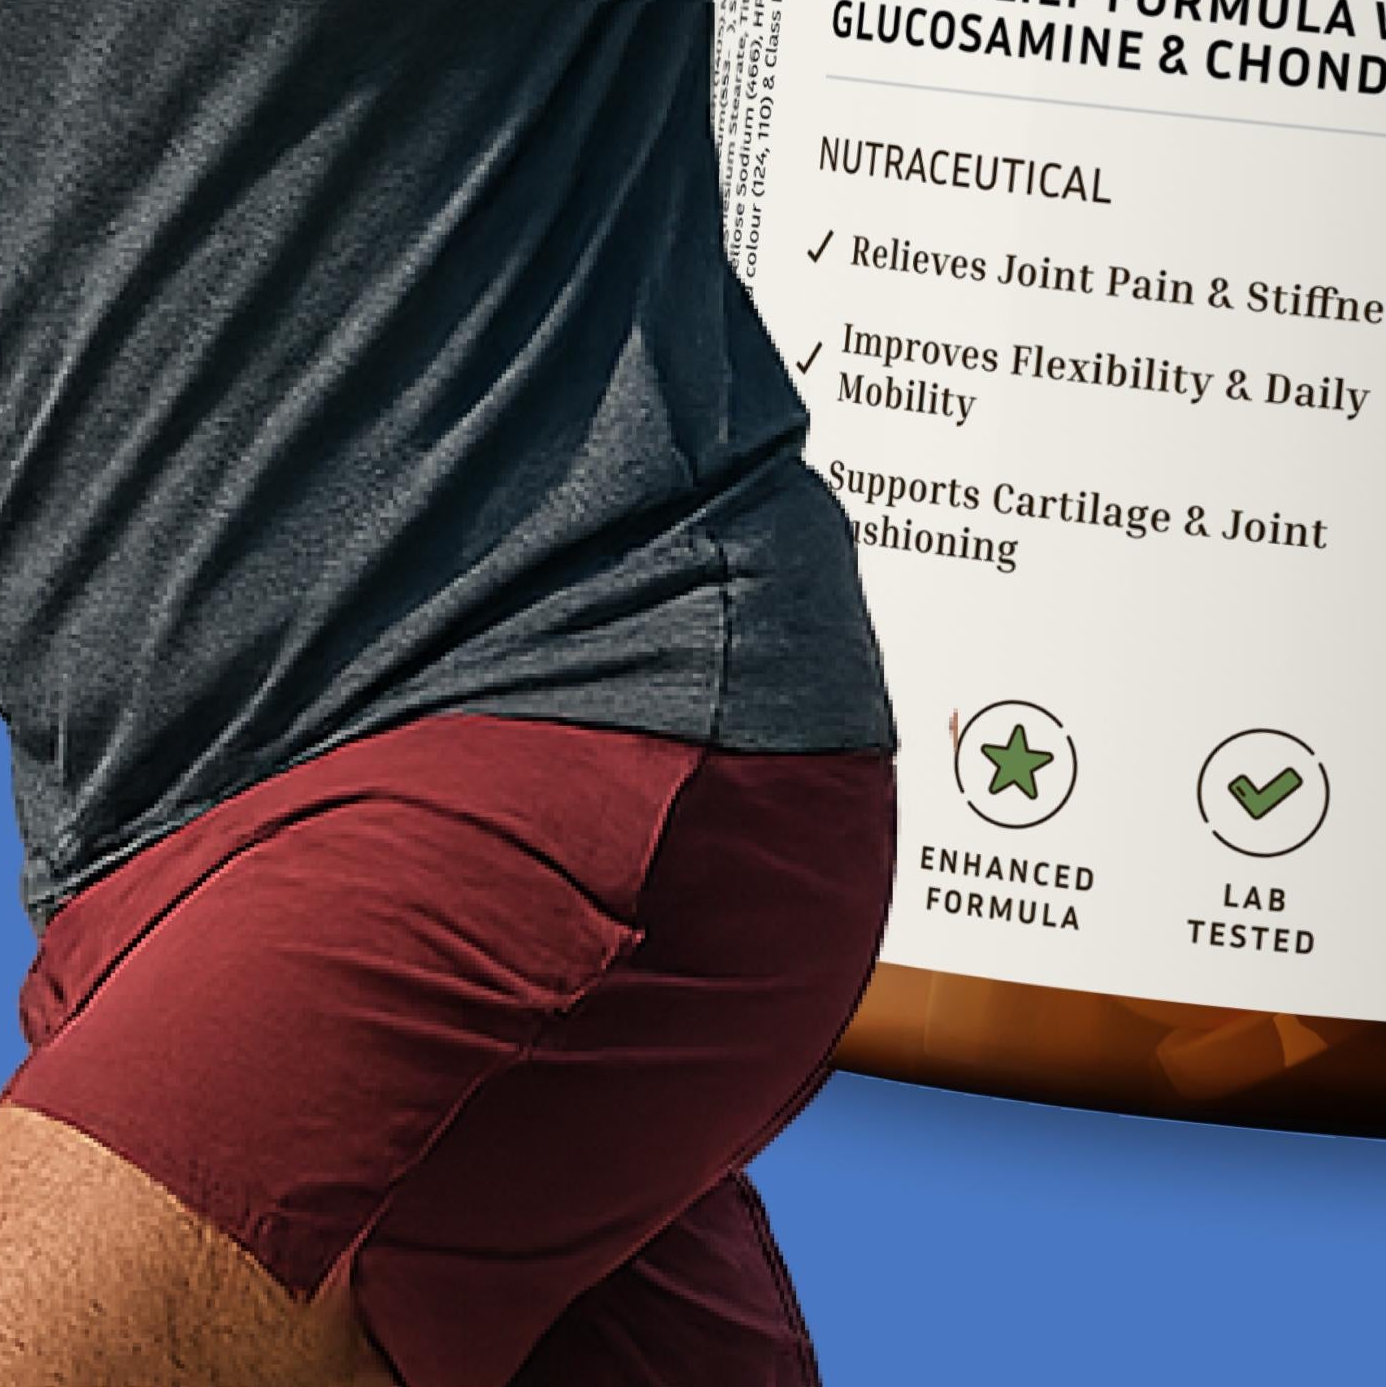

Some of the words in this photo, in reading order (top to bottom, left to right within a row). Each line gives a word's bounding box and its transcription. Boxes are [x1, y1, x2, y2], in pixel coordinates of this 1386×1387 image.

[744, 34, 763, 101] (466),
[764, 9, 782, 68] Class
[833, 0, 1143, 70] GLUCOSAMINE
[1159, 35, 1188, 75] &
[728, 32, 748, 135] Stearate,
[762, 75, 776, 91] &
[757, 96, 774, 140] 110)
[736, 106, 754, 197] Sodium
[751, 146, 771, 198] (124,
[820, 136, 1111, 204] NUTRACEUTICAL
[744, 203, 762, 279] colour
[851, 236, 986, 281] Relieves
[998, 254, 1094, 294] Joint
[1107, 266, 1194, 305] Pain
[1208, 278, 1234, 309] &
[838, 372, 977, 427] Mobility
[842, 323, 997, 372] Improves
[1011, 345, 1214, 404] Flexibility
[1226, 369, 1252, 401] &
[1265, 373, 1370, 420] Daily
[829, 460, 980, 509] Supports
[994, 483, 1170, 539] Cartilage
[1184, 505, 1210, 537] &
[1222, 510, 1327, 549] Joint
[921, 846, 1093, 891] ENHANCED
[1224, 883, 1285, 912] LAB
[927, 887, 1079, 930] FORMULA
[1187, 920, 1314, 954] TESTED
